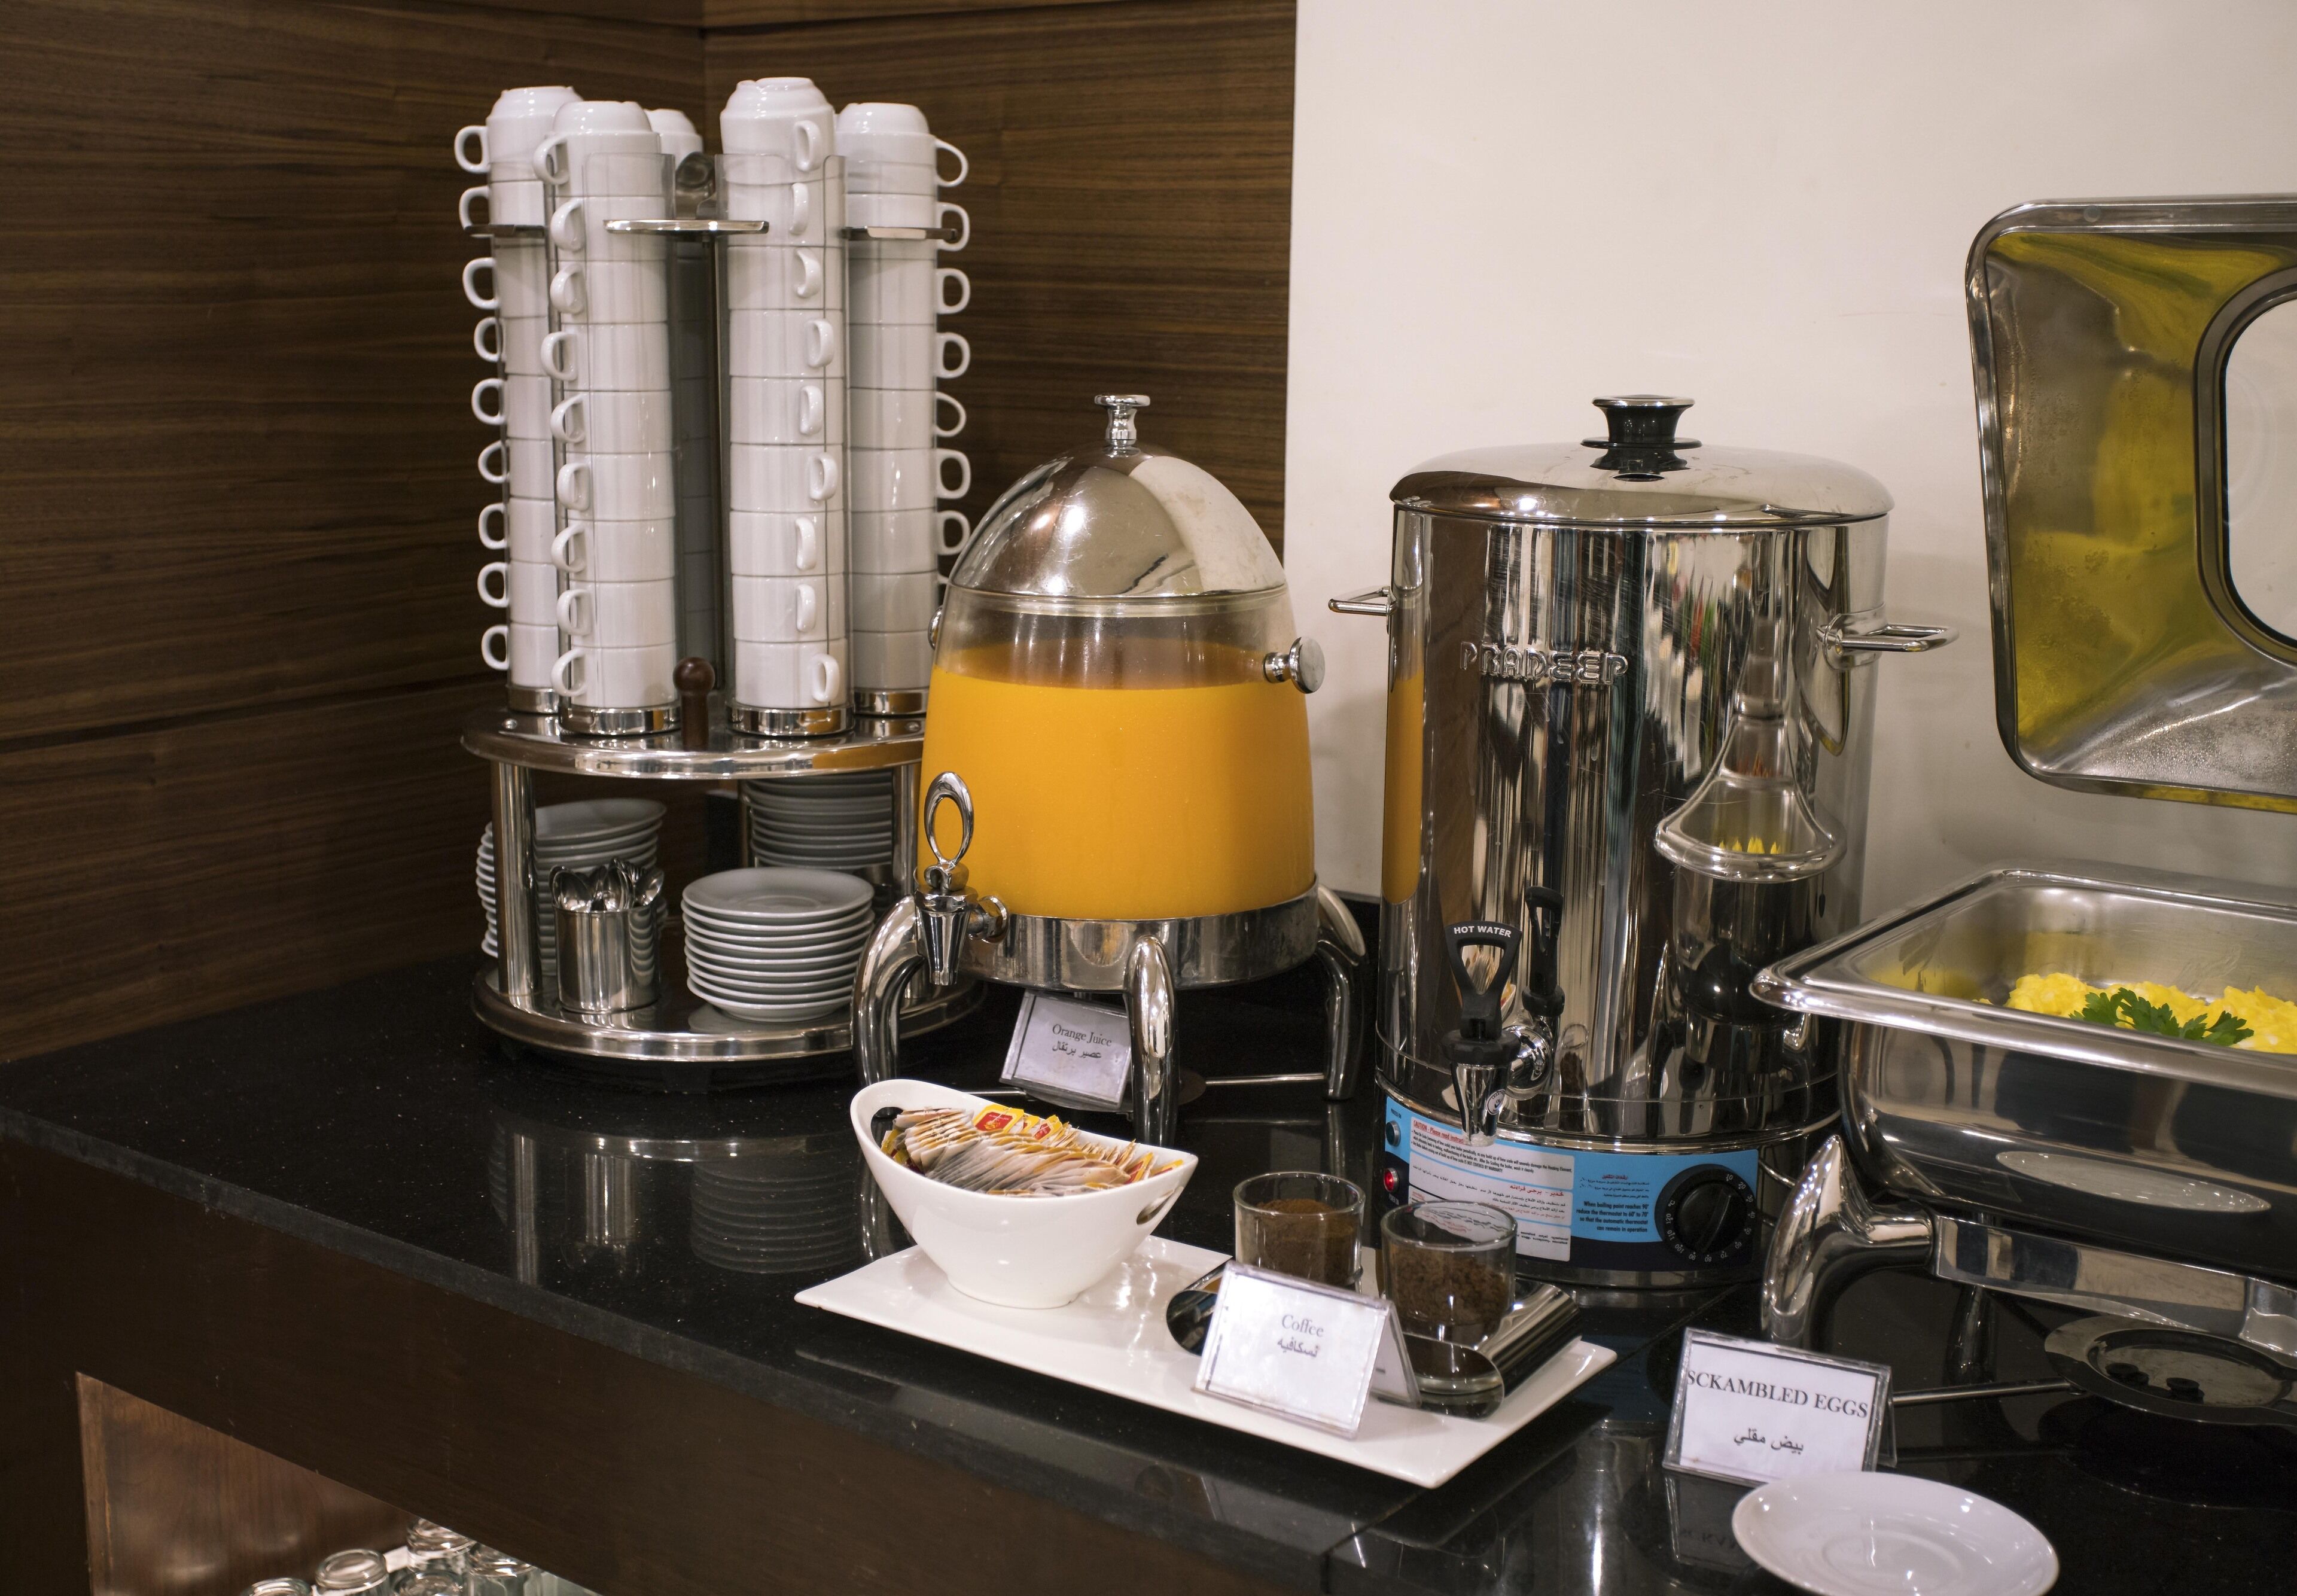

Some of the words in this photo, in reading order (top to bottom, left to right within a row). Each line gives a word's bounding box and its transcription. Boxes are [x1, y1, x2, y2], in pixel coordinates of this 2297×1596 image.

[1460, 641, 1628, 684] PRADEEP
[1454, 926, 1475, 934] HOT
[1477, 926, 1512, 938] WATER
[1052, 1024, 1087, 1043] Orange
[1087, 1032, 1112, 1047] Juice
[1052, 1040, 1076, 1056] برتقال
[1079, 1050, 1101, 1059] عصير
[1413, 1120, 1427, 1131] CAUTION
[1430, 1127, 1441, 1137] Please
[1451, 1134, 1464, 1143] instruct
[1675, 1244, 1684, 1254] 100
[1282, 1314, 1324, 1338] Coffee
[1687, 1370, 1808, 1405] SCKAMBLED
[1815, 1393, 1868, 1418] EGGS
[1734, 1427, 1766, 1445] مقلي
[1771, 1436, 1804, 1454] بيض
